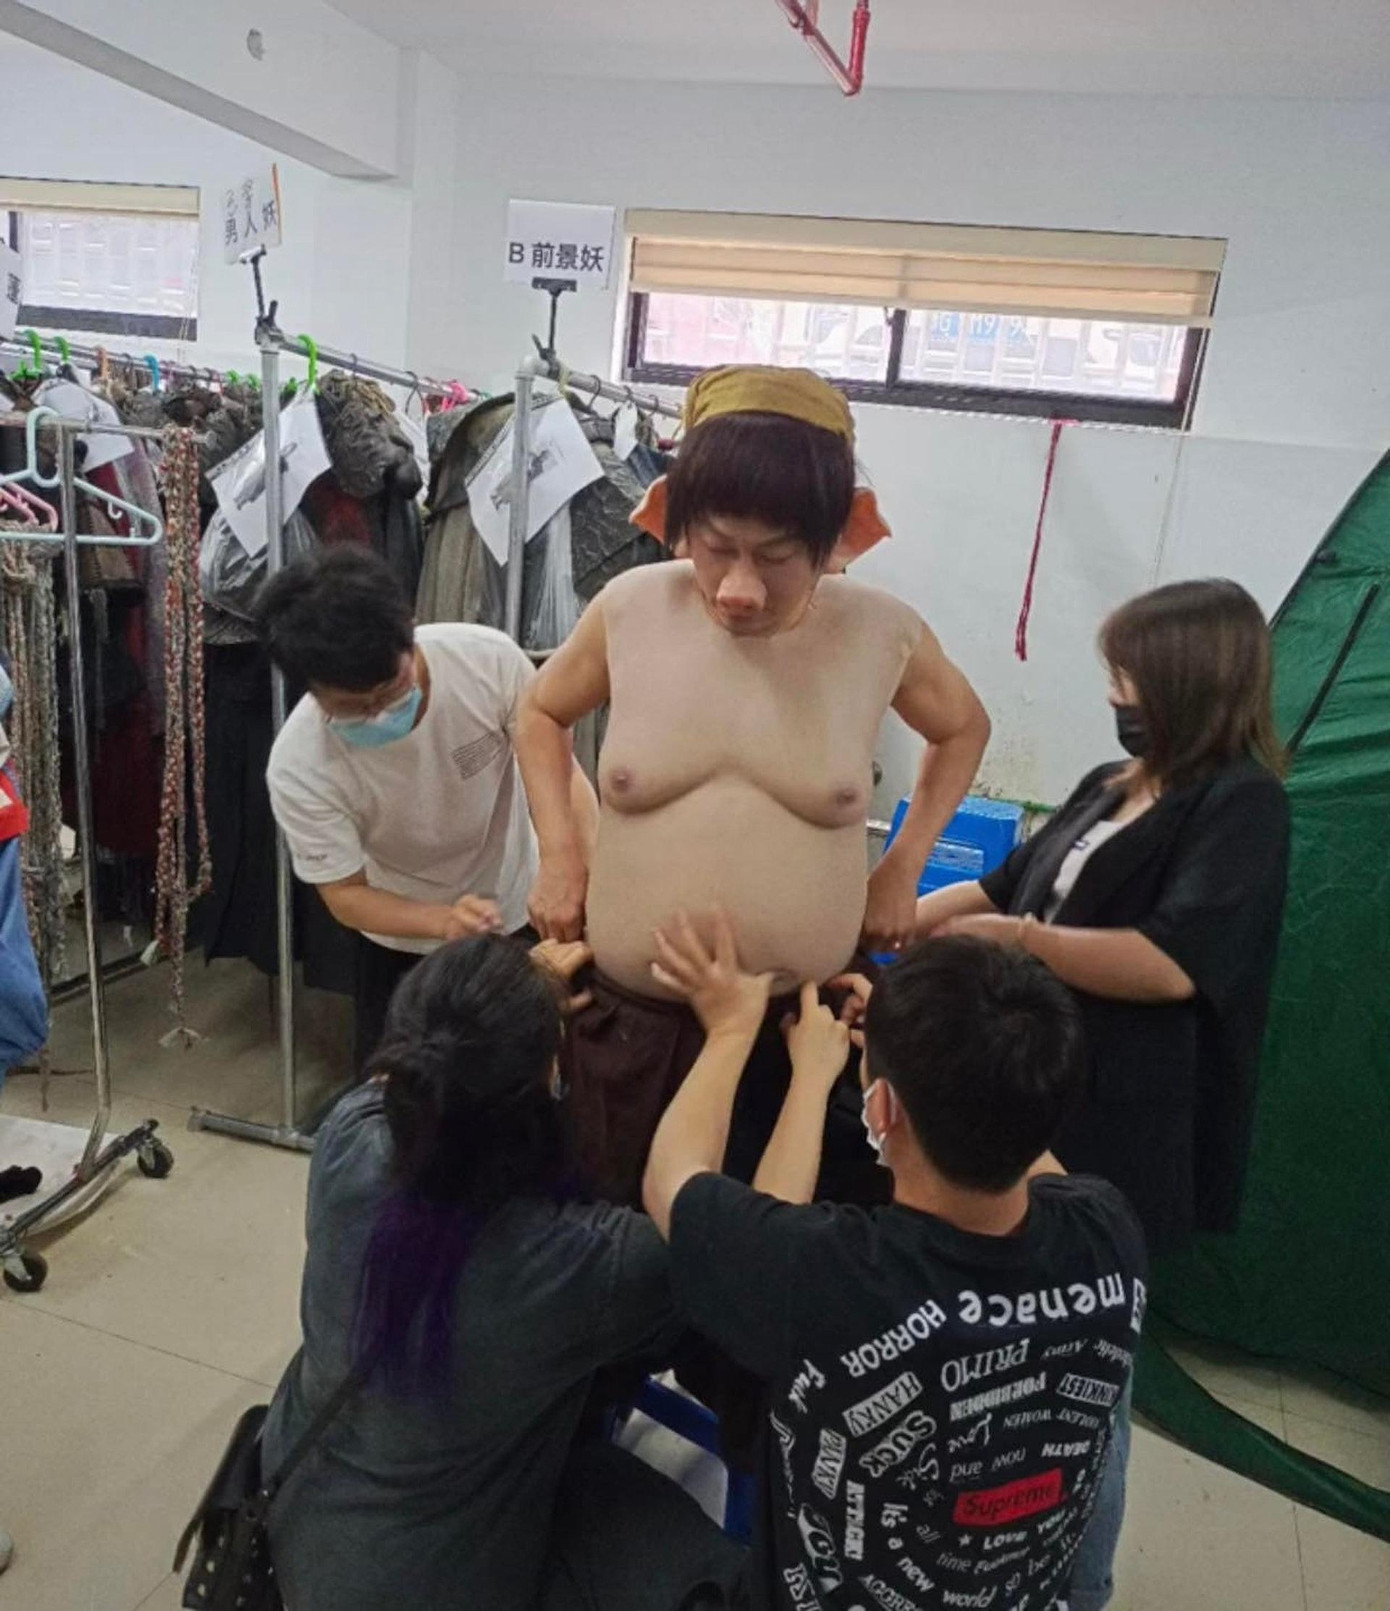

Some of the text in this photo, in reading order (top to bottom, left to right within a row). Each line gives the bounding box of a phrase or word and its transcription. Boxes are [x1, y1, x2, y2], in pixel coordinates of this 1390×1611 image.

[508, 241, 605, 272] B 前景妖
[957, 1272, 1126, 1327] menace
[840, 1299, 948, 1378] HORROR
[940, 1338, 1030, 1392] PRIMO
[842, 1371, 924, 1438] HANKY
[858, 1409, 938, 1479] SUCK
[948, 1461, 983, 1482] and
[961, 1484, 1057, 1520] Supreme
[897, 1555, 936, 1592] new
[943, 1585, 998, 1608] world
